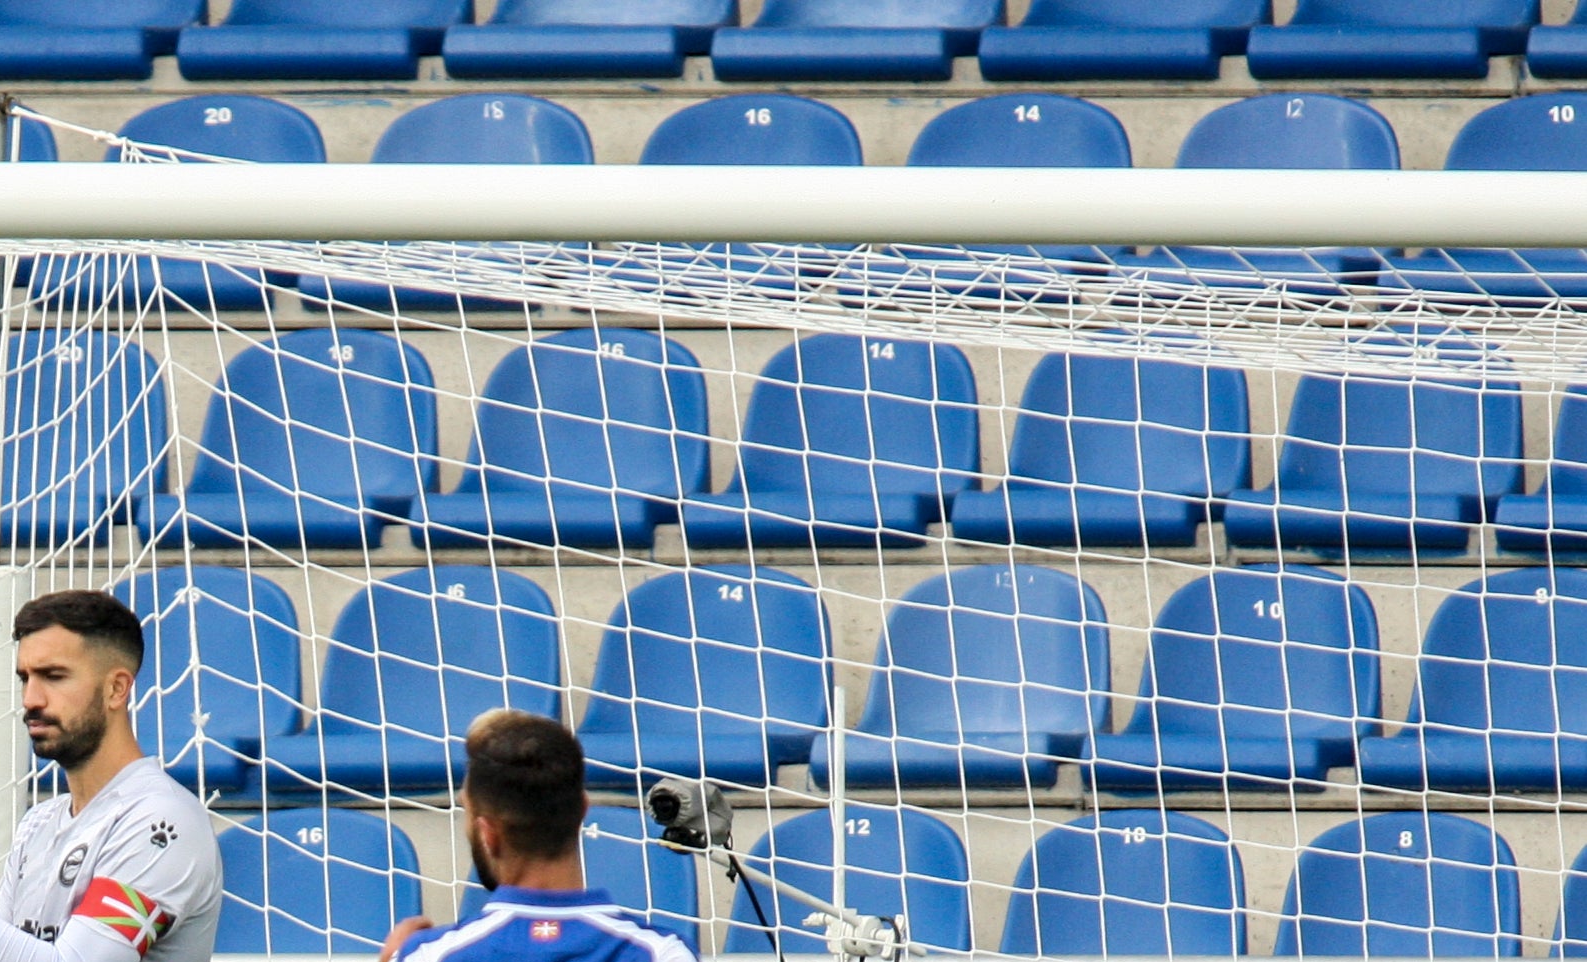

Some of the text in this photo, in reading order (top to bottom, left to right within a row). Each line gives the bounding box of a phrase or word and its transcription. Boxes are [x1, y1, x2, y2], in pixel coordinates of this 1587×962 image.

[204, 107, 232, 125] 20
[745, 108, 771, 125] 16
[1014, 105, 1041, 123] 14
[1286, 98, 1304, 118] 12
[1549, 105, 1575, 123] 10
[869, 343, 895, 359] 14
[718, 585, 743, 601] 14
[1253, 600, 1281, 618] 10
[845, 819, 870, 835] 12
[297, 828, 323, 844] 16
[1399, 831, 1412, 848] 8
